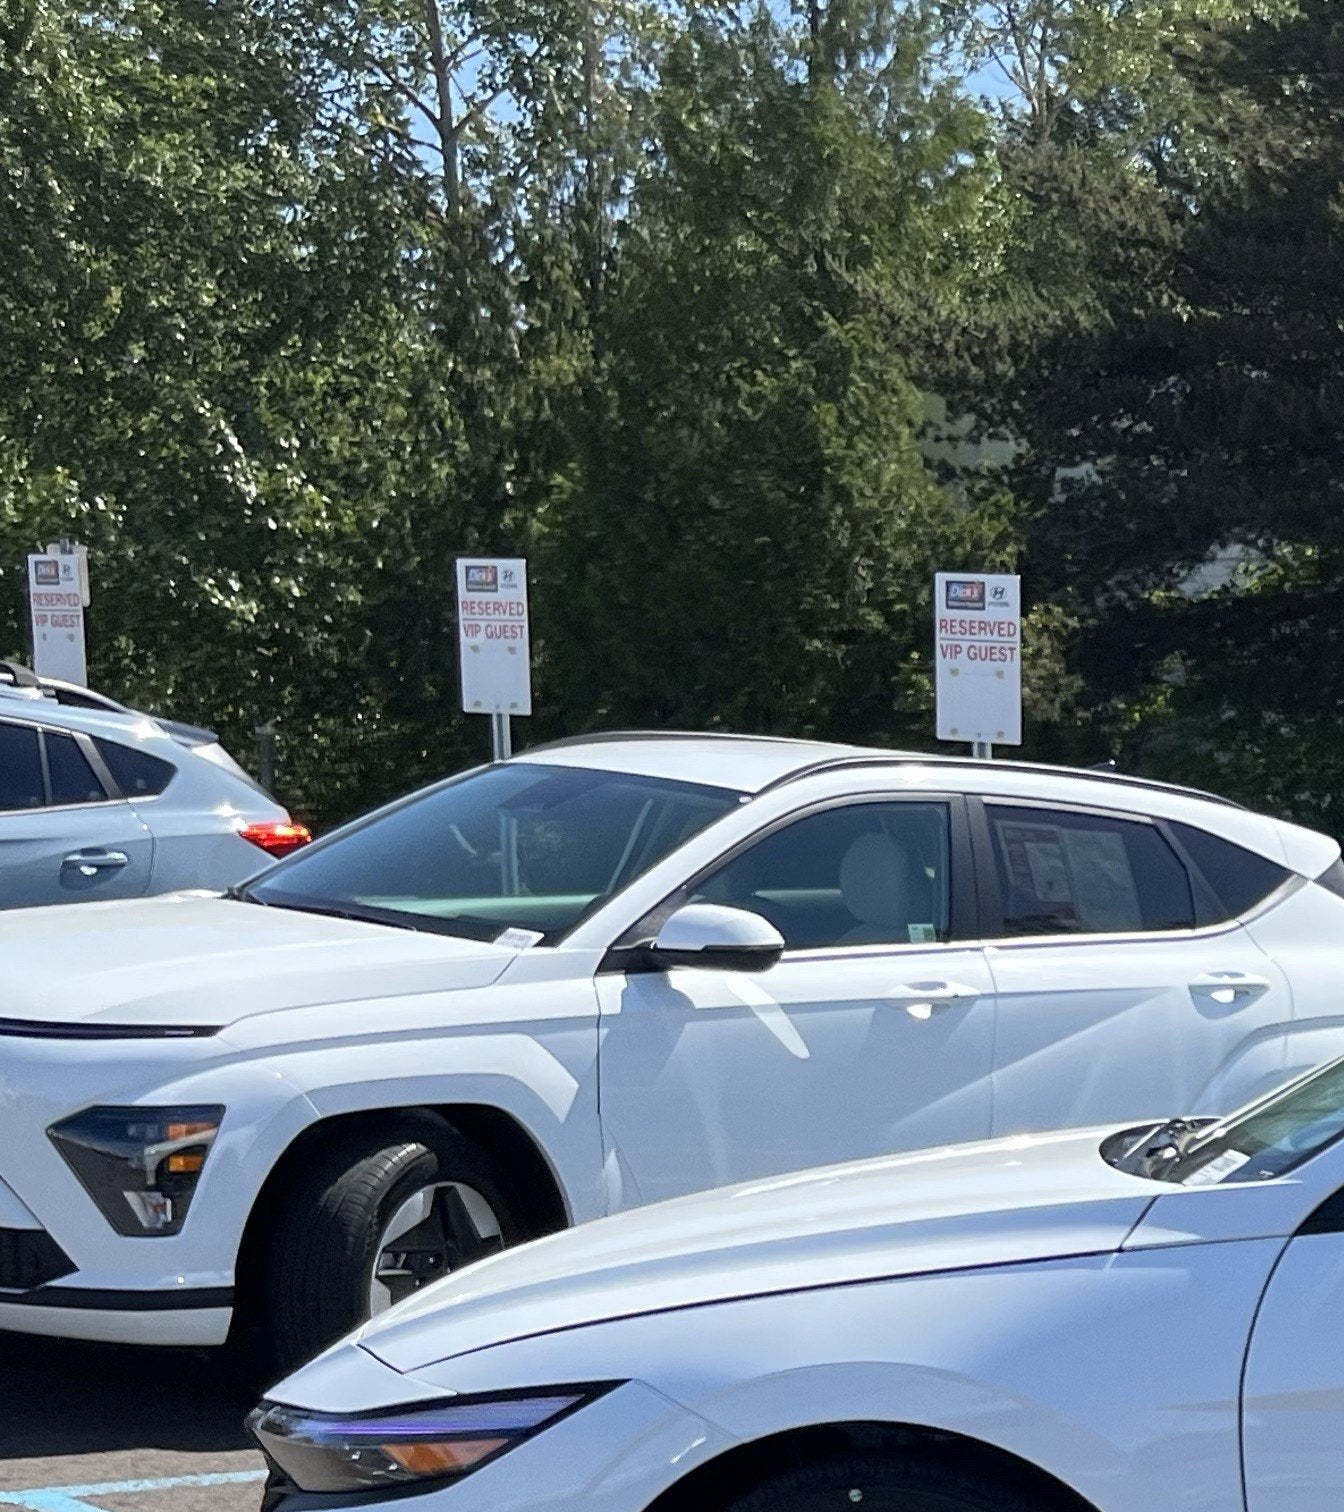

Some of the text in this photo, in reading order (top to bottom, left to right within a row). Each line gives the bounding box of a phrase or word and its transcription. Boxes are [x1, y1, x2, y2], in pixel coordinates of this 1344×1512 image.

[461, 600, 525, 617] RESERVED
[463, 623, 525, 640] VIP GUEST
[940, 619, 1017, 638] RESERVED
[941, 643, 1017, 663] VIP GUEST
